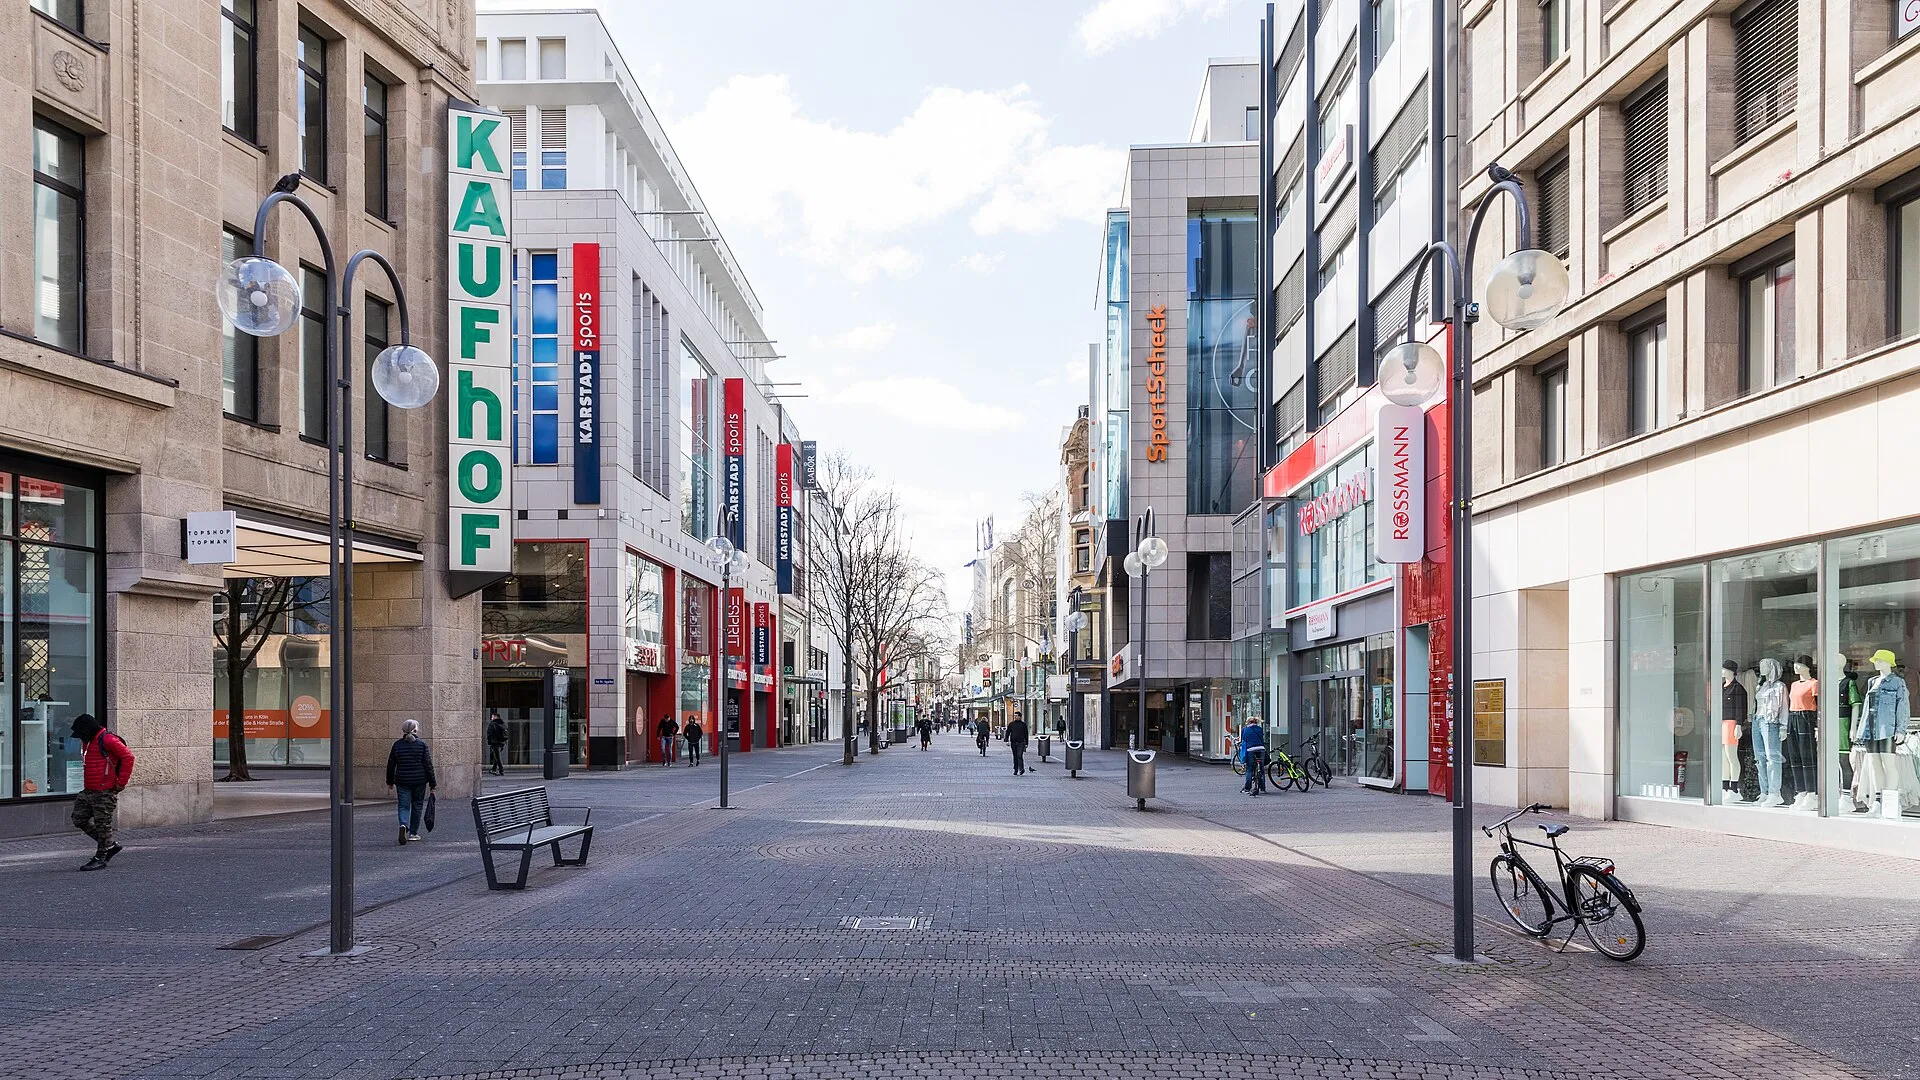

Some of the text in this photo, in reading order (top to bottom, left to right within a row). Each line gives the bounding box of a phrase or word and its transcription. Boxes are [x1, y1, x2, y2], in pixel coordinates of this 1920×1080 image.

[576, 292, 595, 444] KARSTADT sports
[1146, 304, 1169, 463] SportScheck
[727, 413, 741, 453] sports
[778, 472, 790, 560] KARSTADT sports
[1299, 467, 1375, 536] ROSSMANN
[1393, 426, 1409, 540] ROSSMANN
[728, 595, 740, 648] ESPRIT
[758, 604, 766, 626] sports
[482, 639, 527, 661] PRIT
